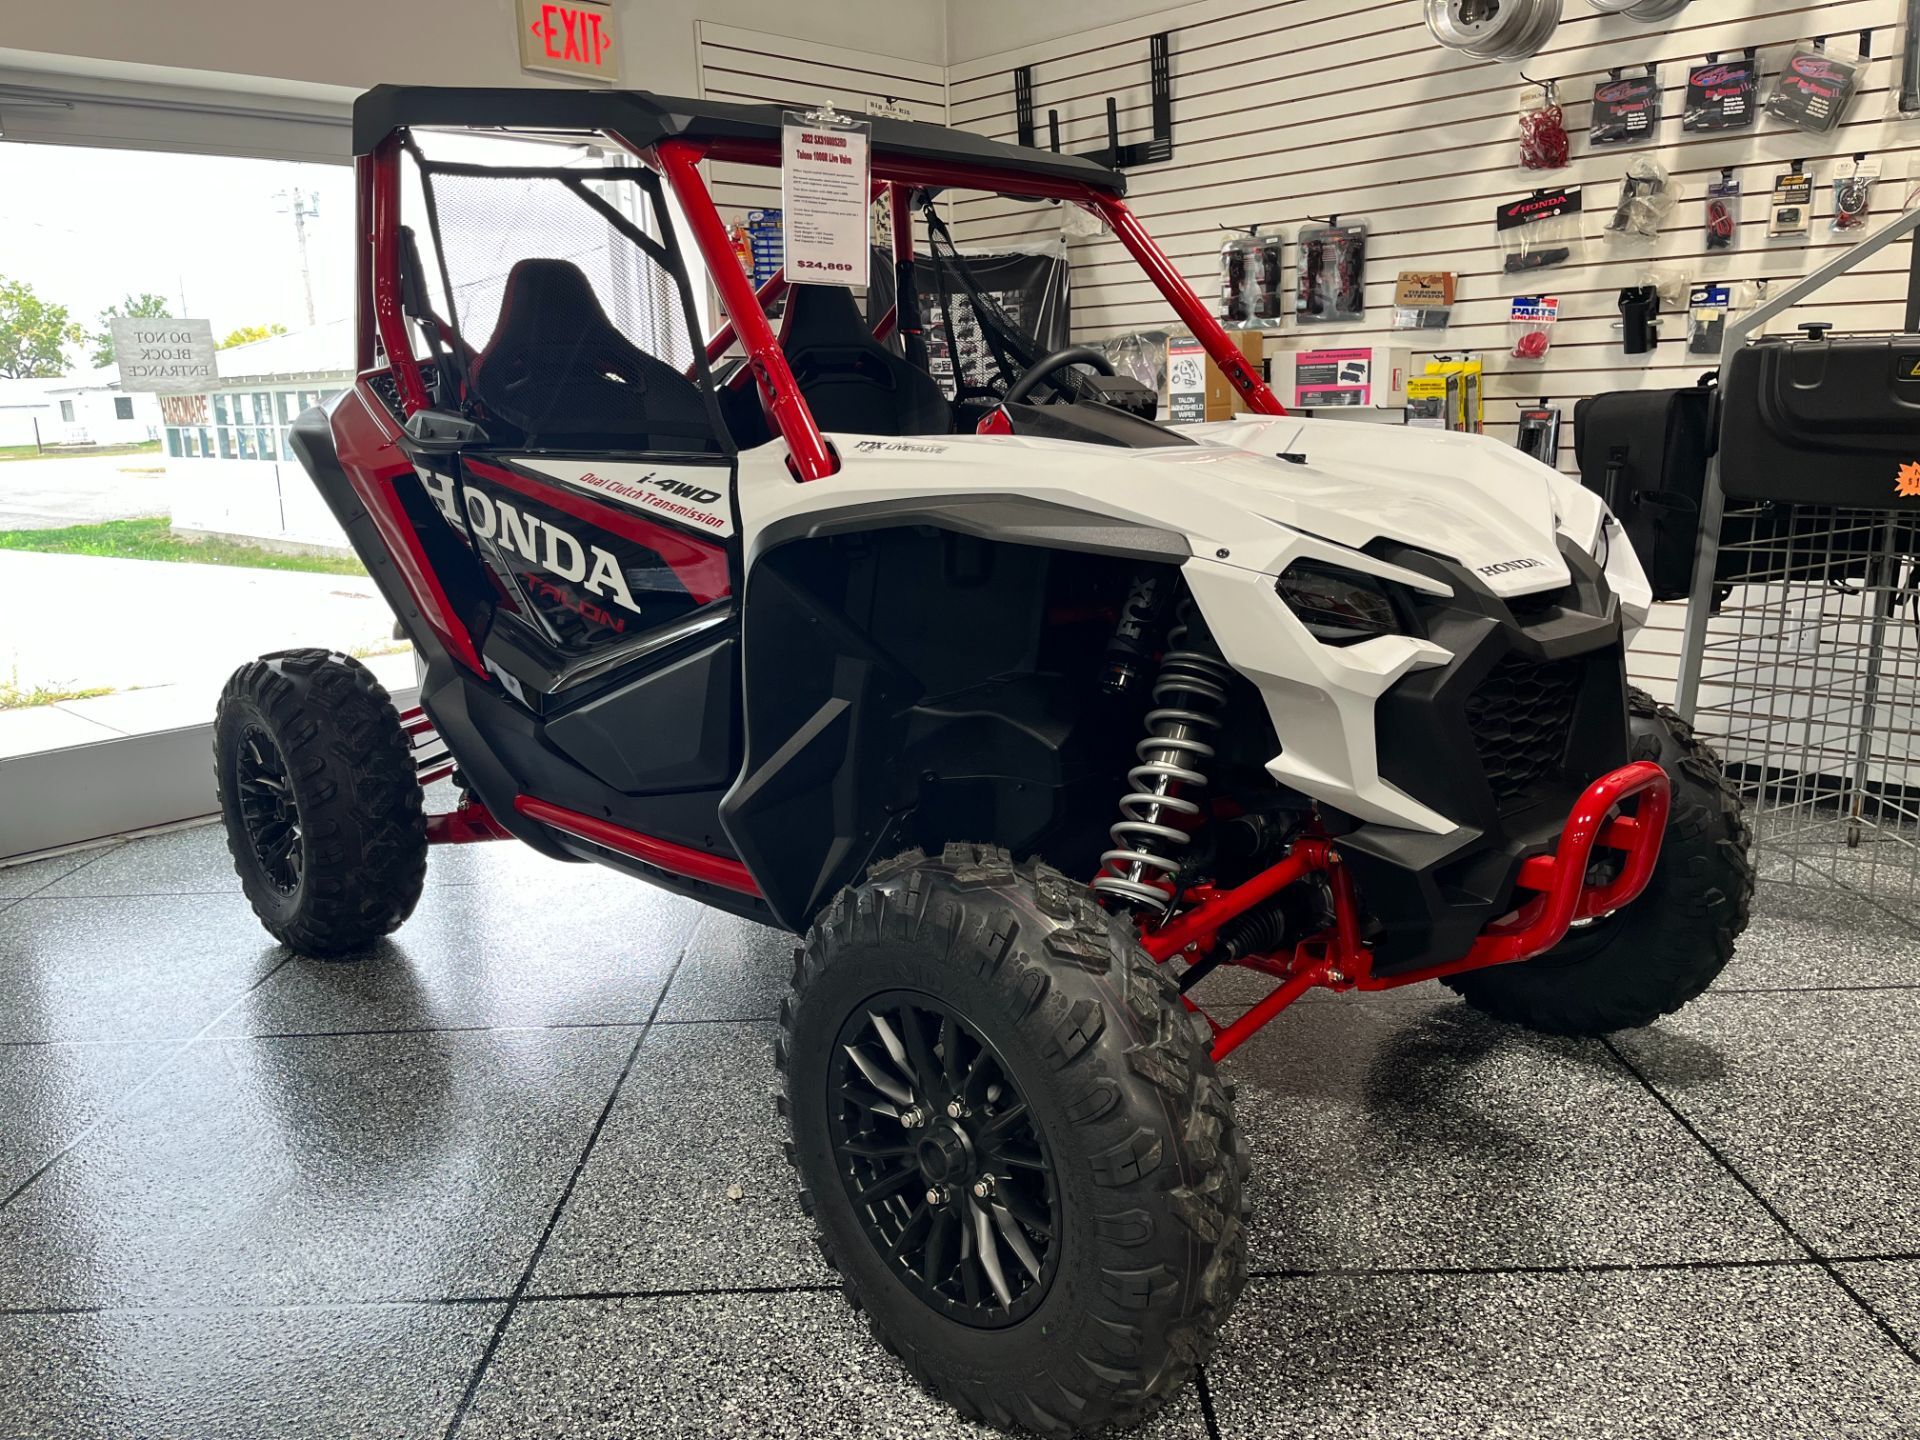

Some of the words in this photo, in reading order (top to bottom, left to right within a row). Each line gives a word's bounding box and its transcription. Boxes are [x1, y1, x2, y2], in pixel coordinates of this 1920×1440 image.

[543, 4, 602, 65] EXIT
[829, 153, 838, 164] Live
[1520, 196, 1567, 213] HONDA
[796, 260, 853, 271] $24,869
[1511, 307, 1556, 317] PARTS
[159, 394, 209, 425] HARDWARE
[579, 472, 607, 490] Dual
[607, 481, 643, 500] Clutch
[643, 492, 725, 528] Transmission
[636, 471, 722, 505] i-4WD
[413, 464, 642, 614] HONDA
[1477, 558, 1545, 577] HONDA
[523, 571, 626, 633] TALON
[1115, 575, 1157, 640] FOX
